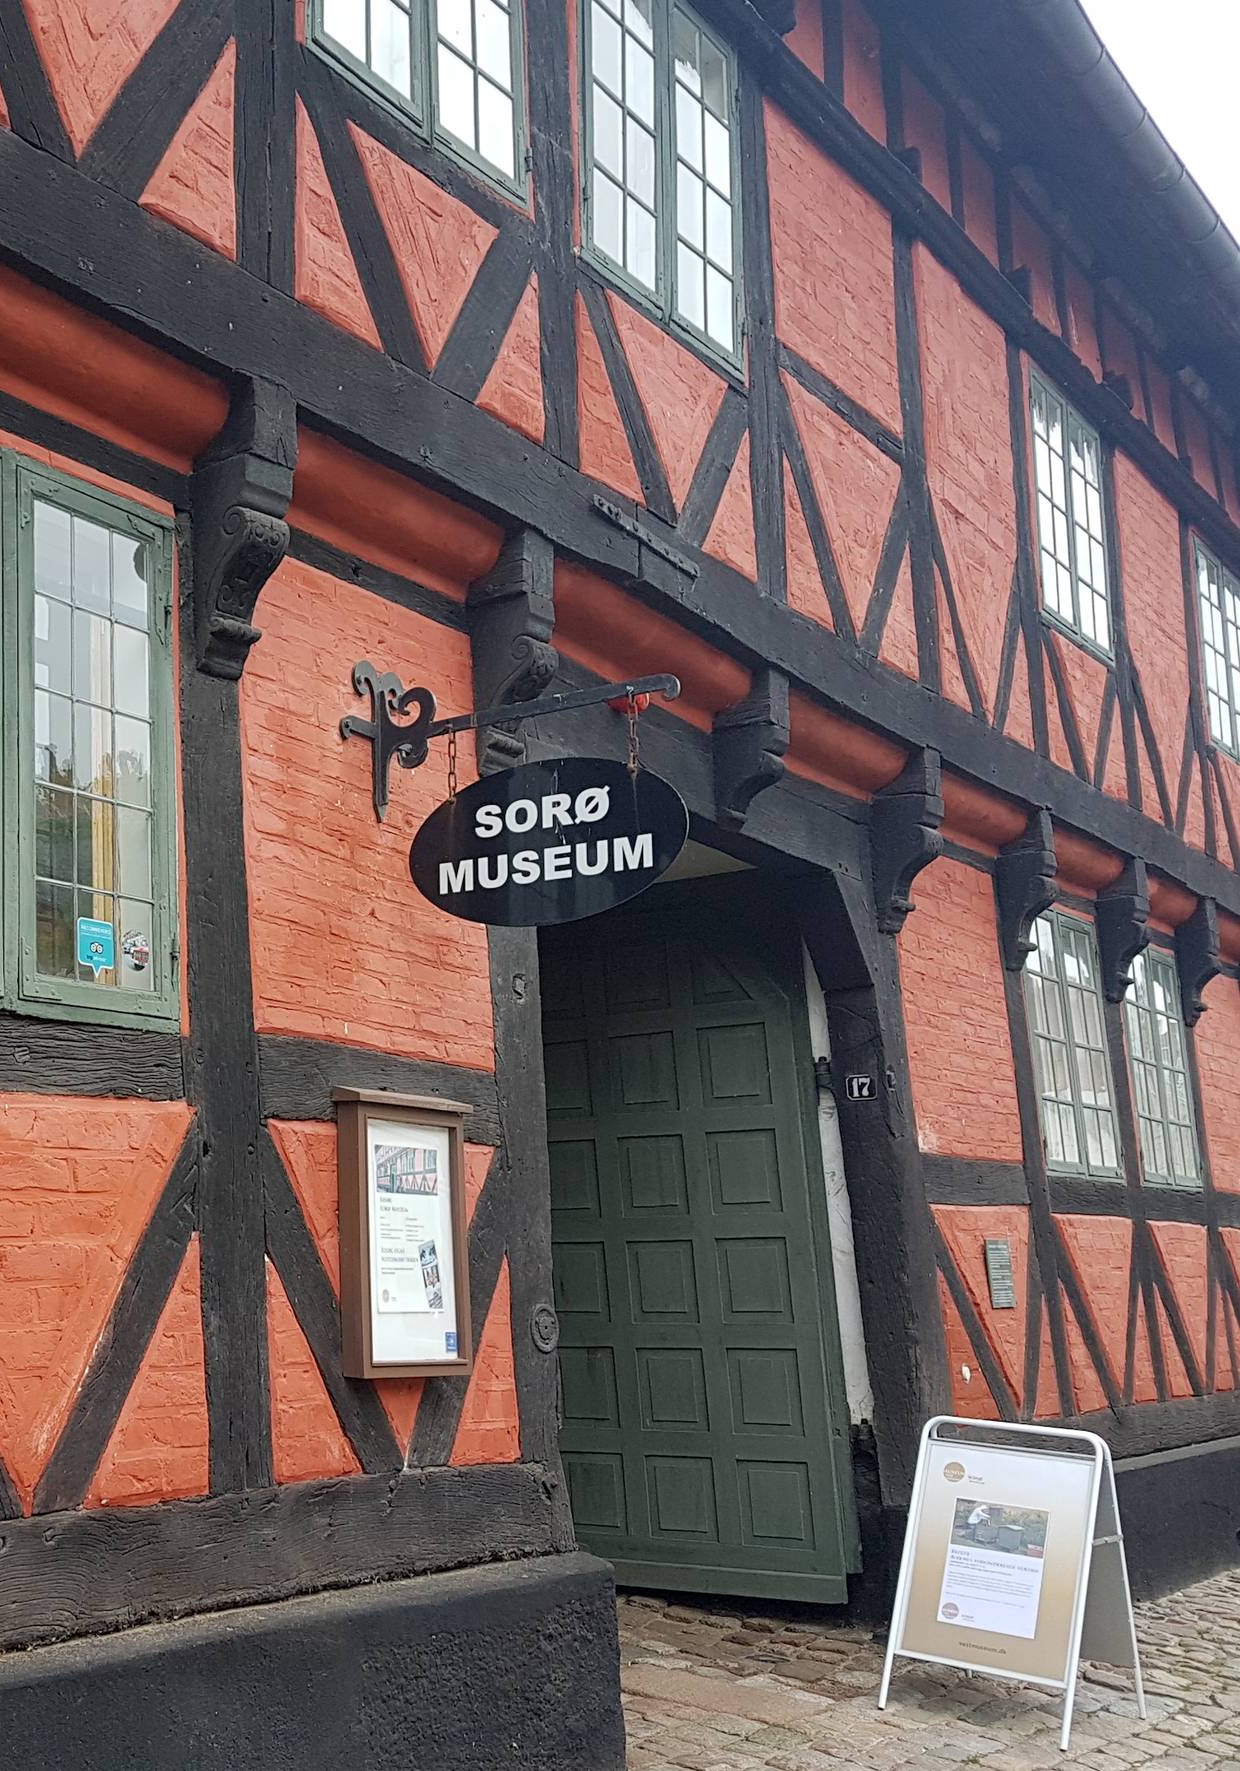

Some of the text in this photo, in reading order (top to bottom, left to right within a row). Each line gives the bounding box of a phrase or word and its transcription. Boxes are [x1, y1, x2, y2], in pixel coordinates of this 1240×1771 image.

[475, 785, 610, 839] SORØ
[438, 833, 654, 895] MUSEUM
[851, 1077, 871, 1097] 17
